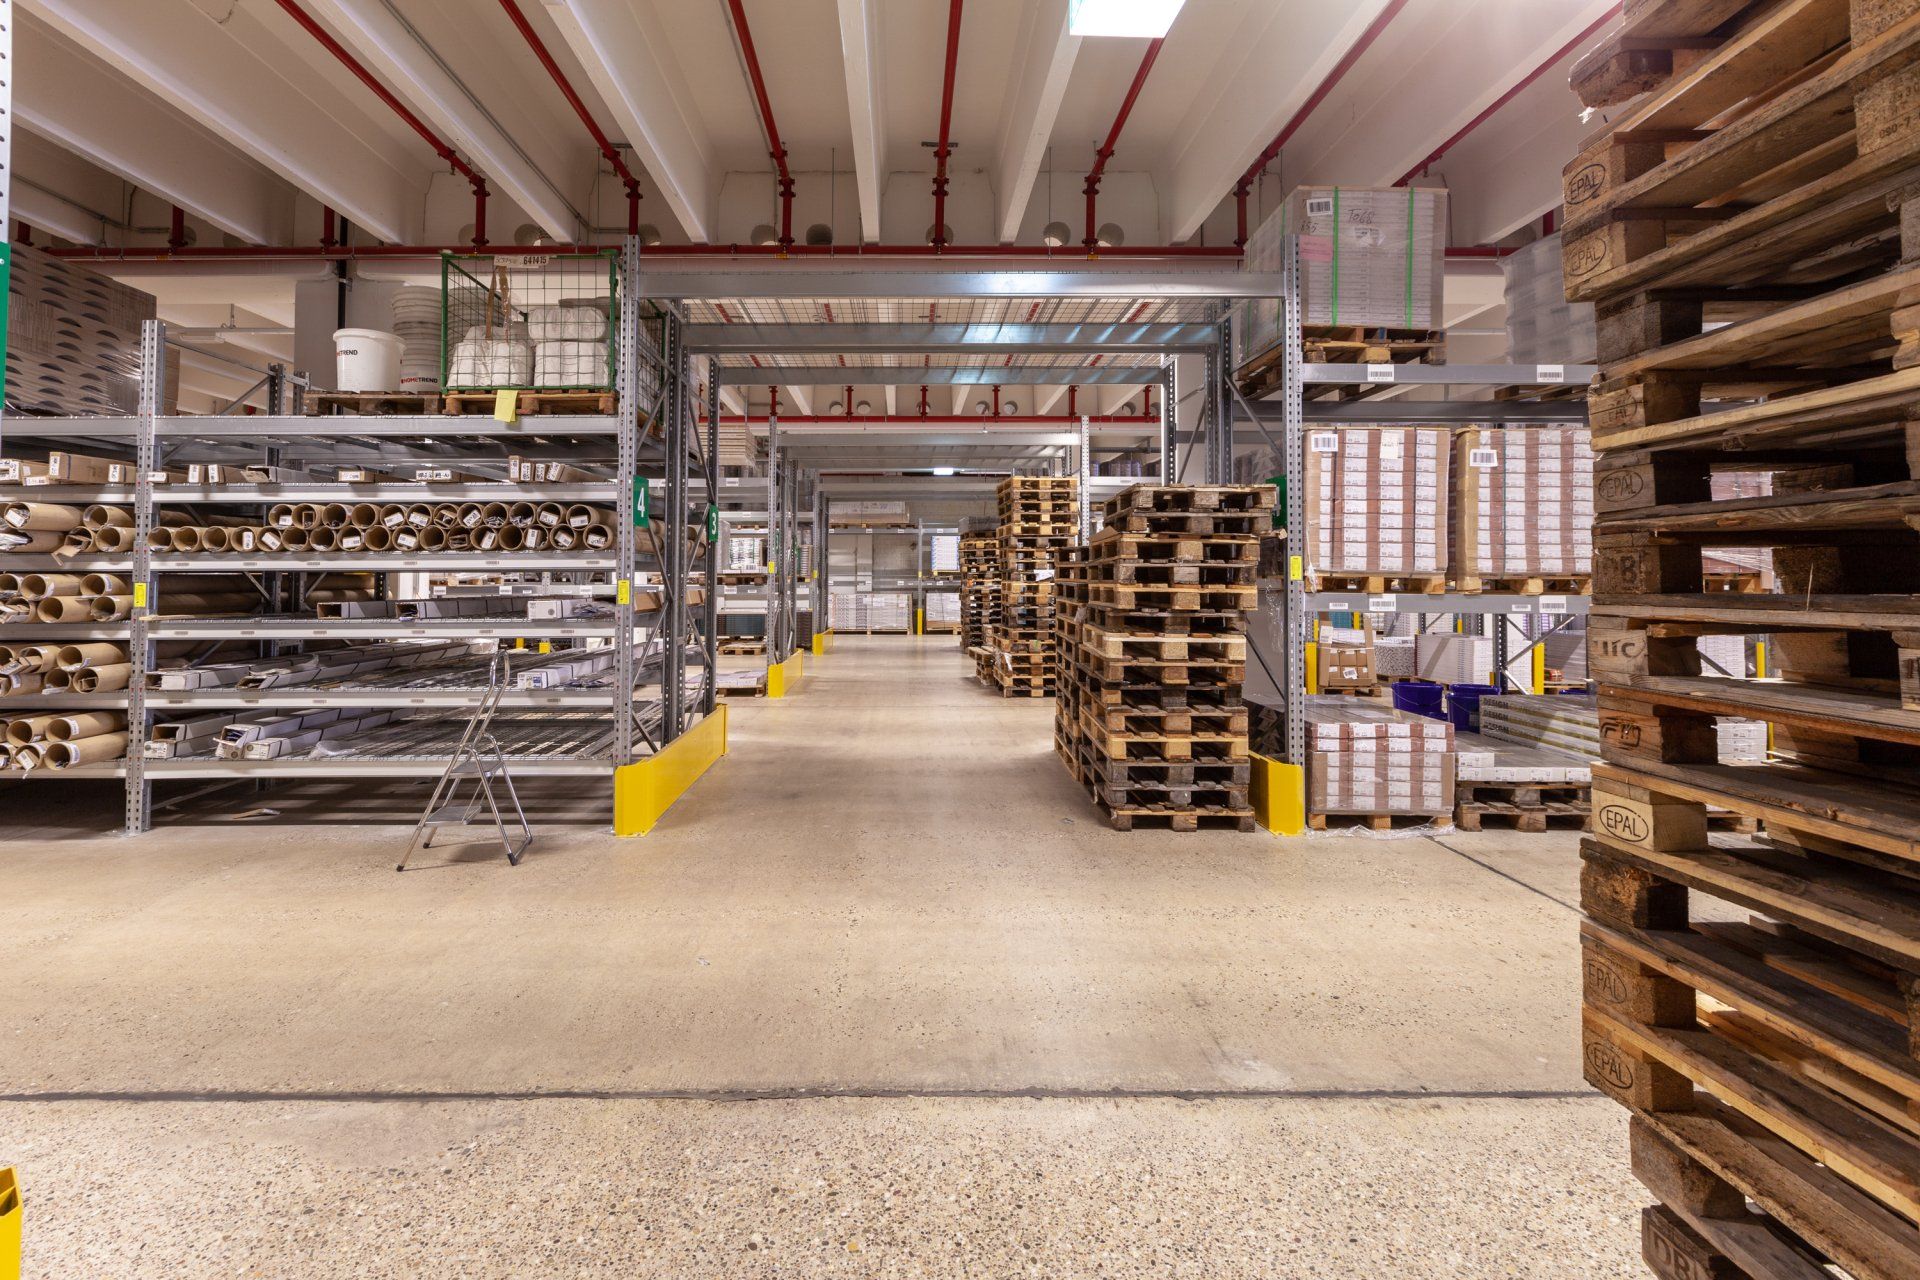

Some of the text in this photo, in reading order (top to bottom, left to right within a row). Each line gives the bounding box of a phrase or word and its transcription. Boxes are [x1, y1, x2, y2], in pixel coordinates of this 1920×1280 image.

[1570, 171, 1600, 200] EPAL
[1571, 247, 1601, 273] EPAL
[1606, 474, 1637, 498] EPAL
[637, 487, 645, 518] 4
[711, 512, 717, 535] 3
[1483, 698, 1509, 710] DESIGN
[1483, 710, 1509, 722] DESIGN
[1606, 809, 1641, 838] EPAL
[1588, 963, 1621, 1001] EPAL
[1594, 1048, 1627, 1086] EPAL
